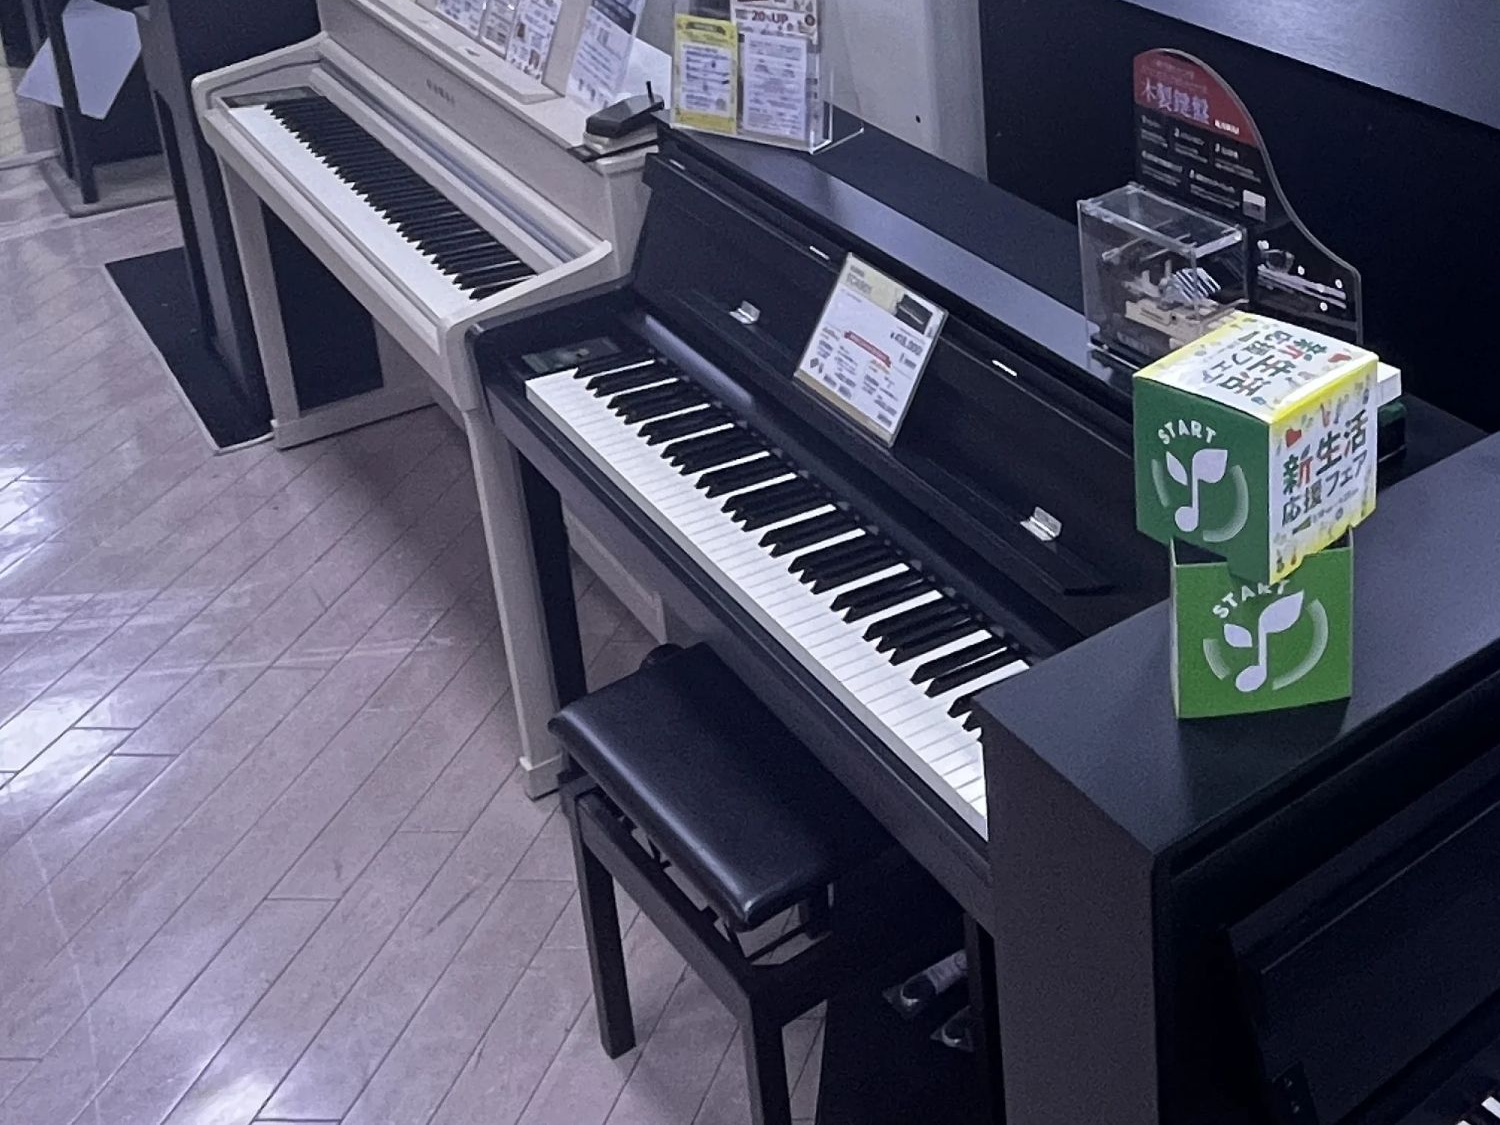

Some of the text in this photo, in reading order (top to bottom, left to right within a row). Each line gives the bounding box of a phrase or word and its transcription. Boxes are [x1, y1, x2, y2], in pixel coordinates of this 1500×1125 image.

[1157, 419, 1217, 445] START
[1282, 409, 1369, 495] 新生活
[1281, 450, 1368, 526] 応援フェア
